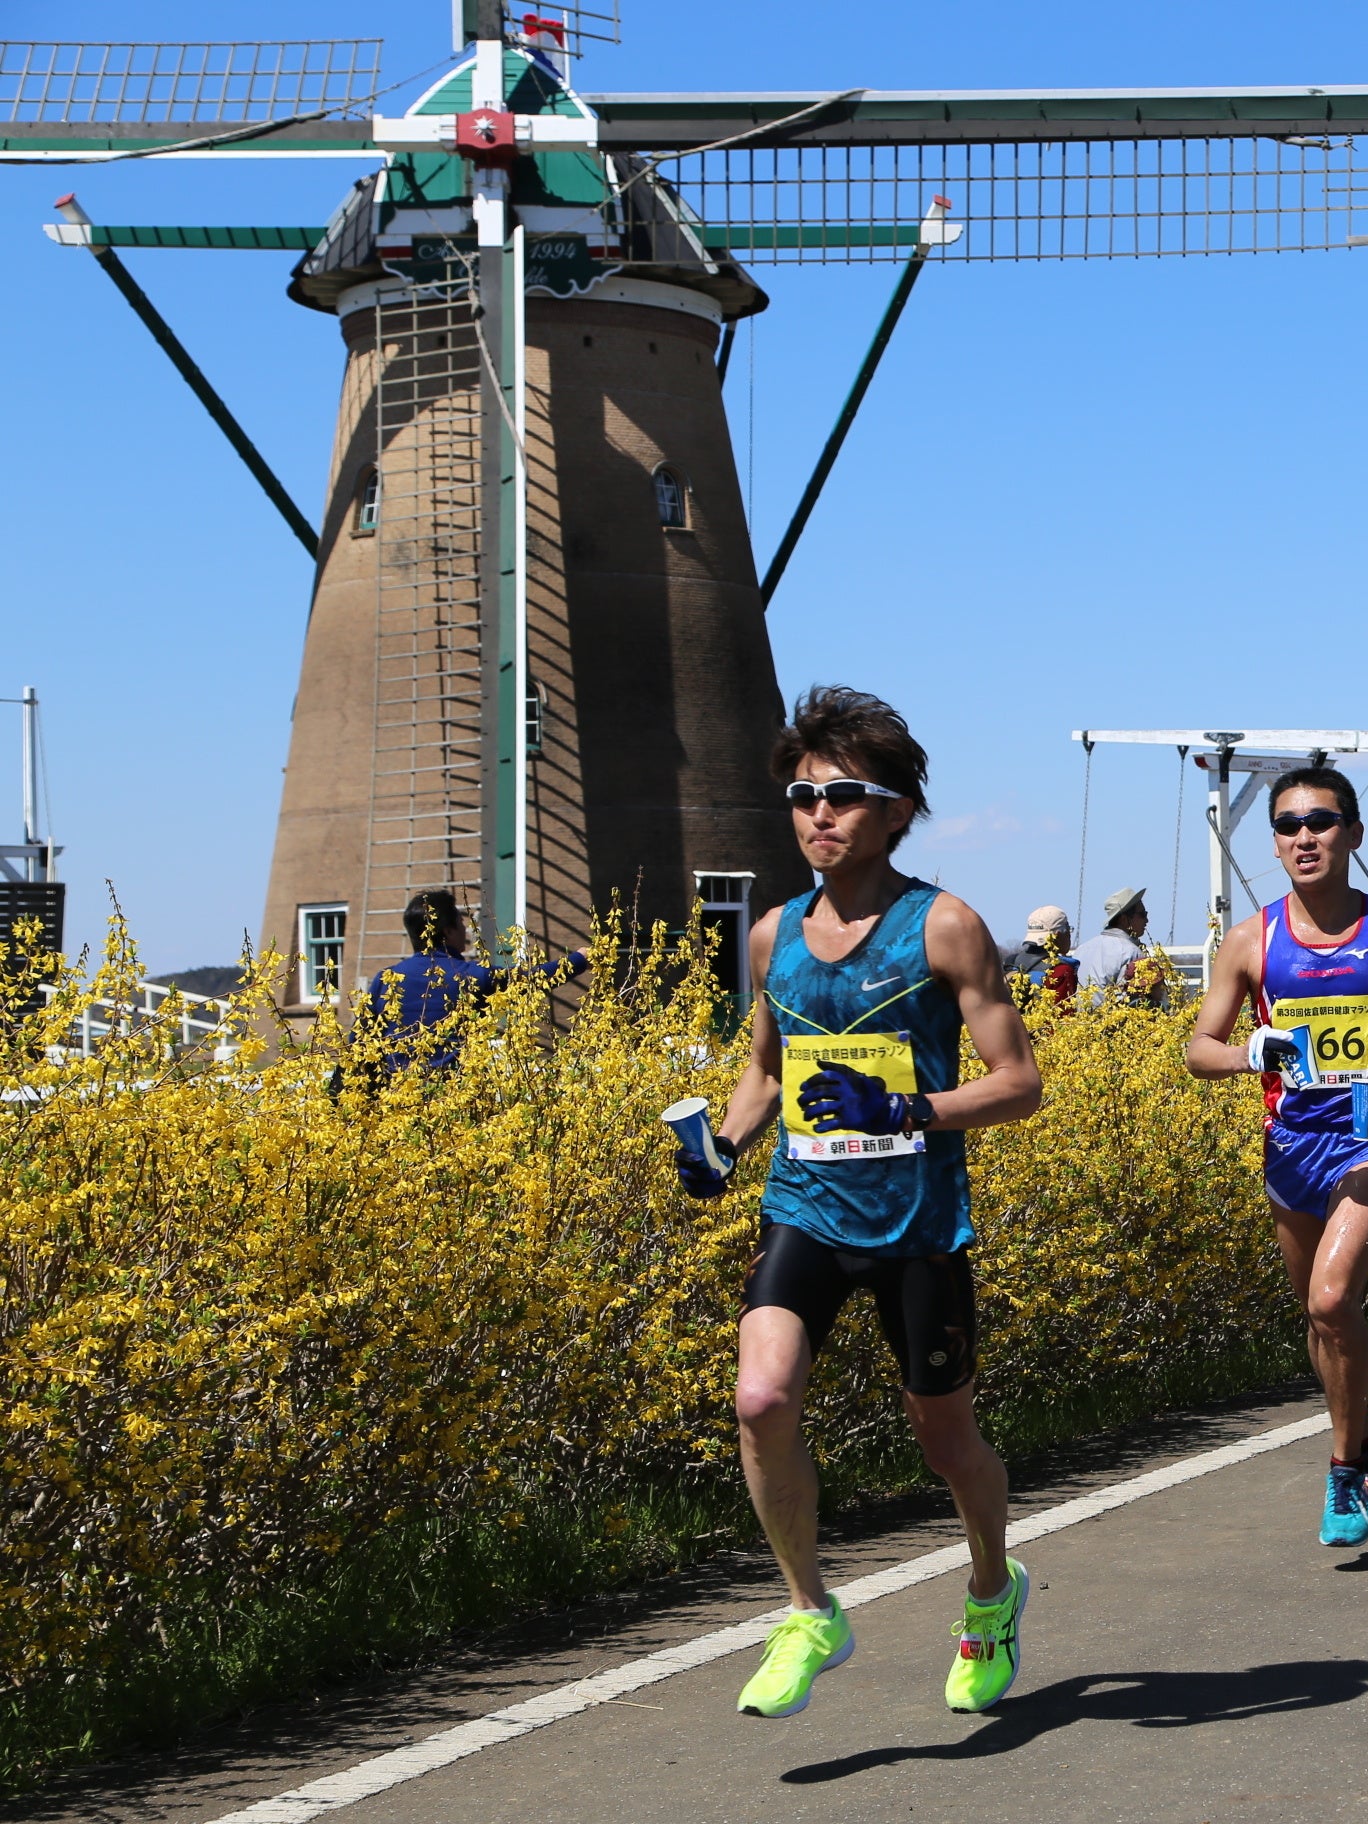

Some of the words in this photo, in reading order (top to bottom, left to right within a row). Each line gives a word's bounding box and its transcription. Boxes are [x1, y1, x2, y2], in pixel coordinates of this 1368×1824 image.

[530, 242, 576, 259] 1994
[1316, 1026, 1366, 1061] 66
[787, 1045, 906, 1061] 第38回佐倉朝日健康マラソン
[830, 1137, 894, 1154] 朝日新聞
